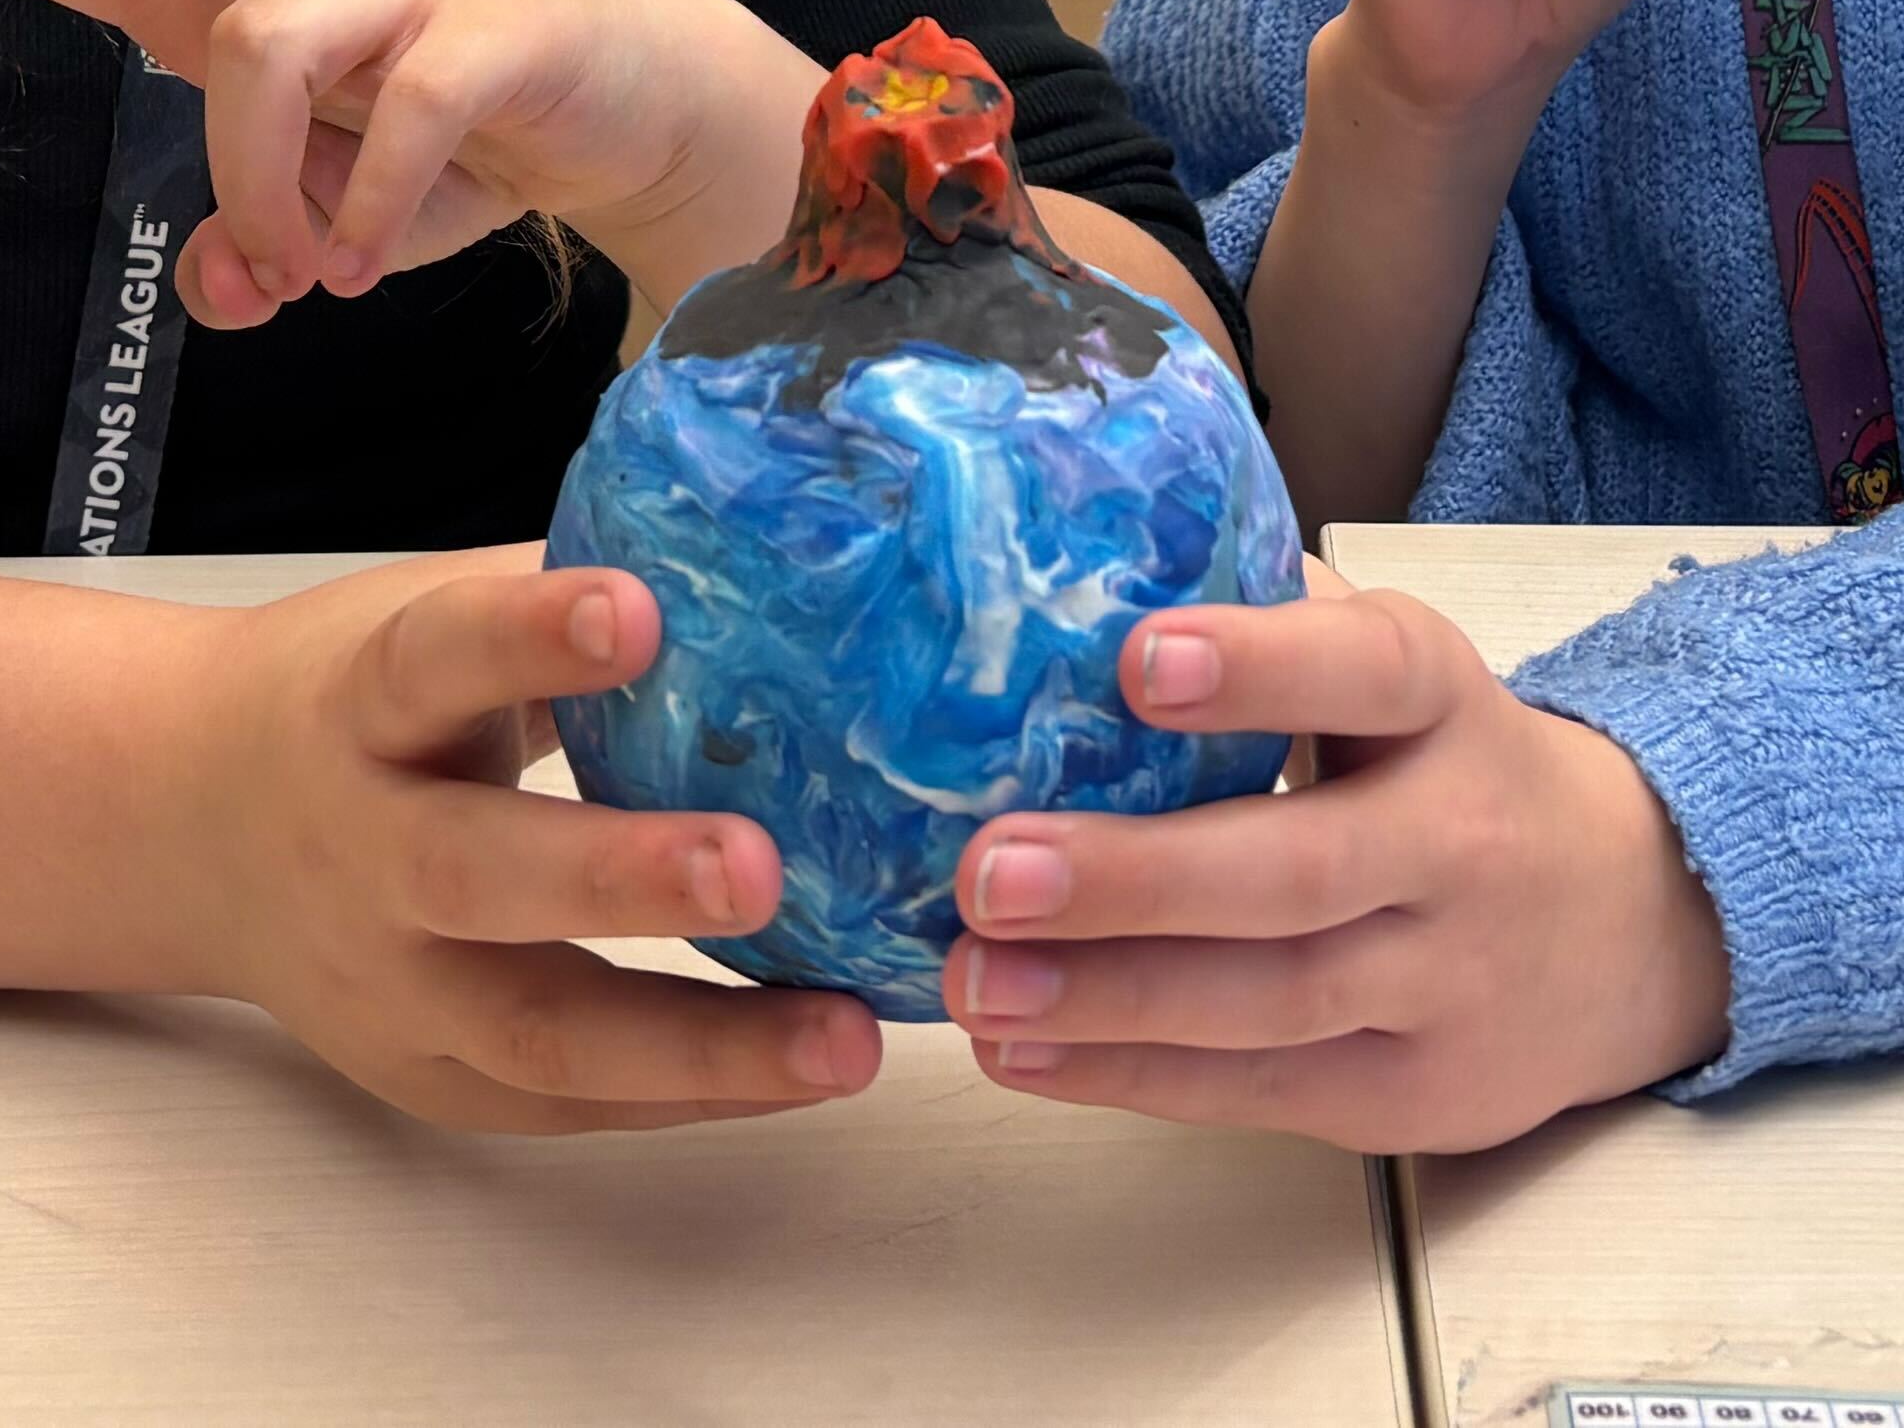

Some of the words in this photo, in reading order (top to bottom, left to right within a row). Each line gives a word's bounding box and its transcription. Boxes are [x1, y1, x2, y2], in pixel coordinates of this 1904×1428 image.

[78, 403, 136, 557] ATIONS
[1577, 1402, 1631, 1419] 100
[1649, 1403, 1689, 1420] 90
